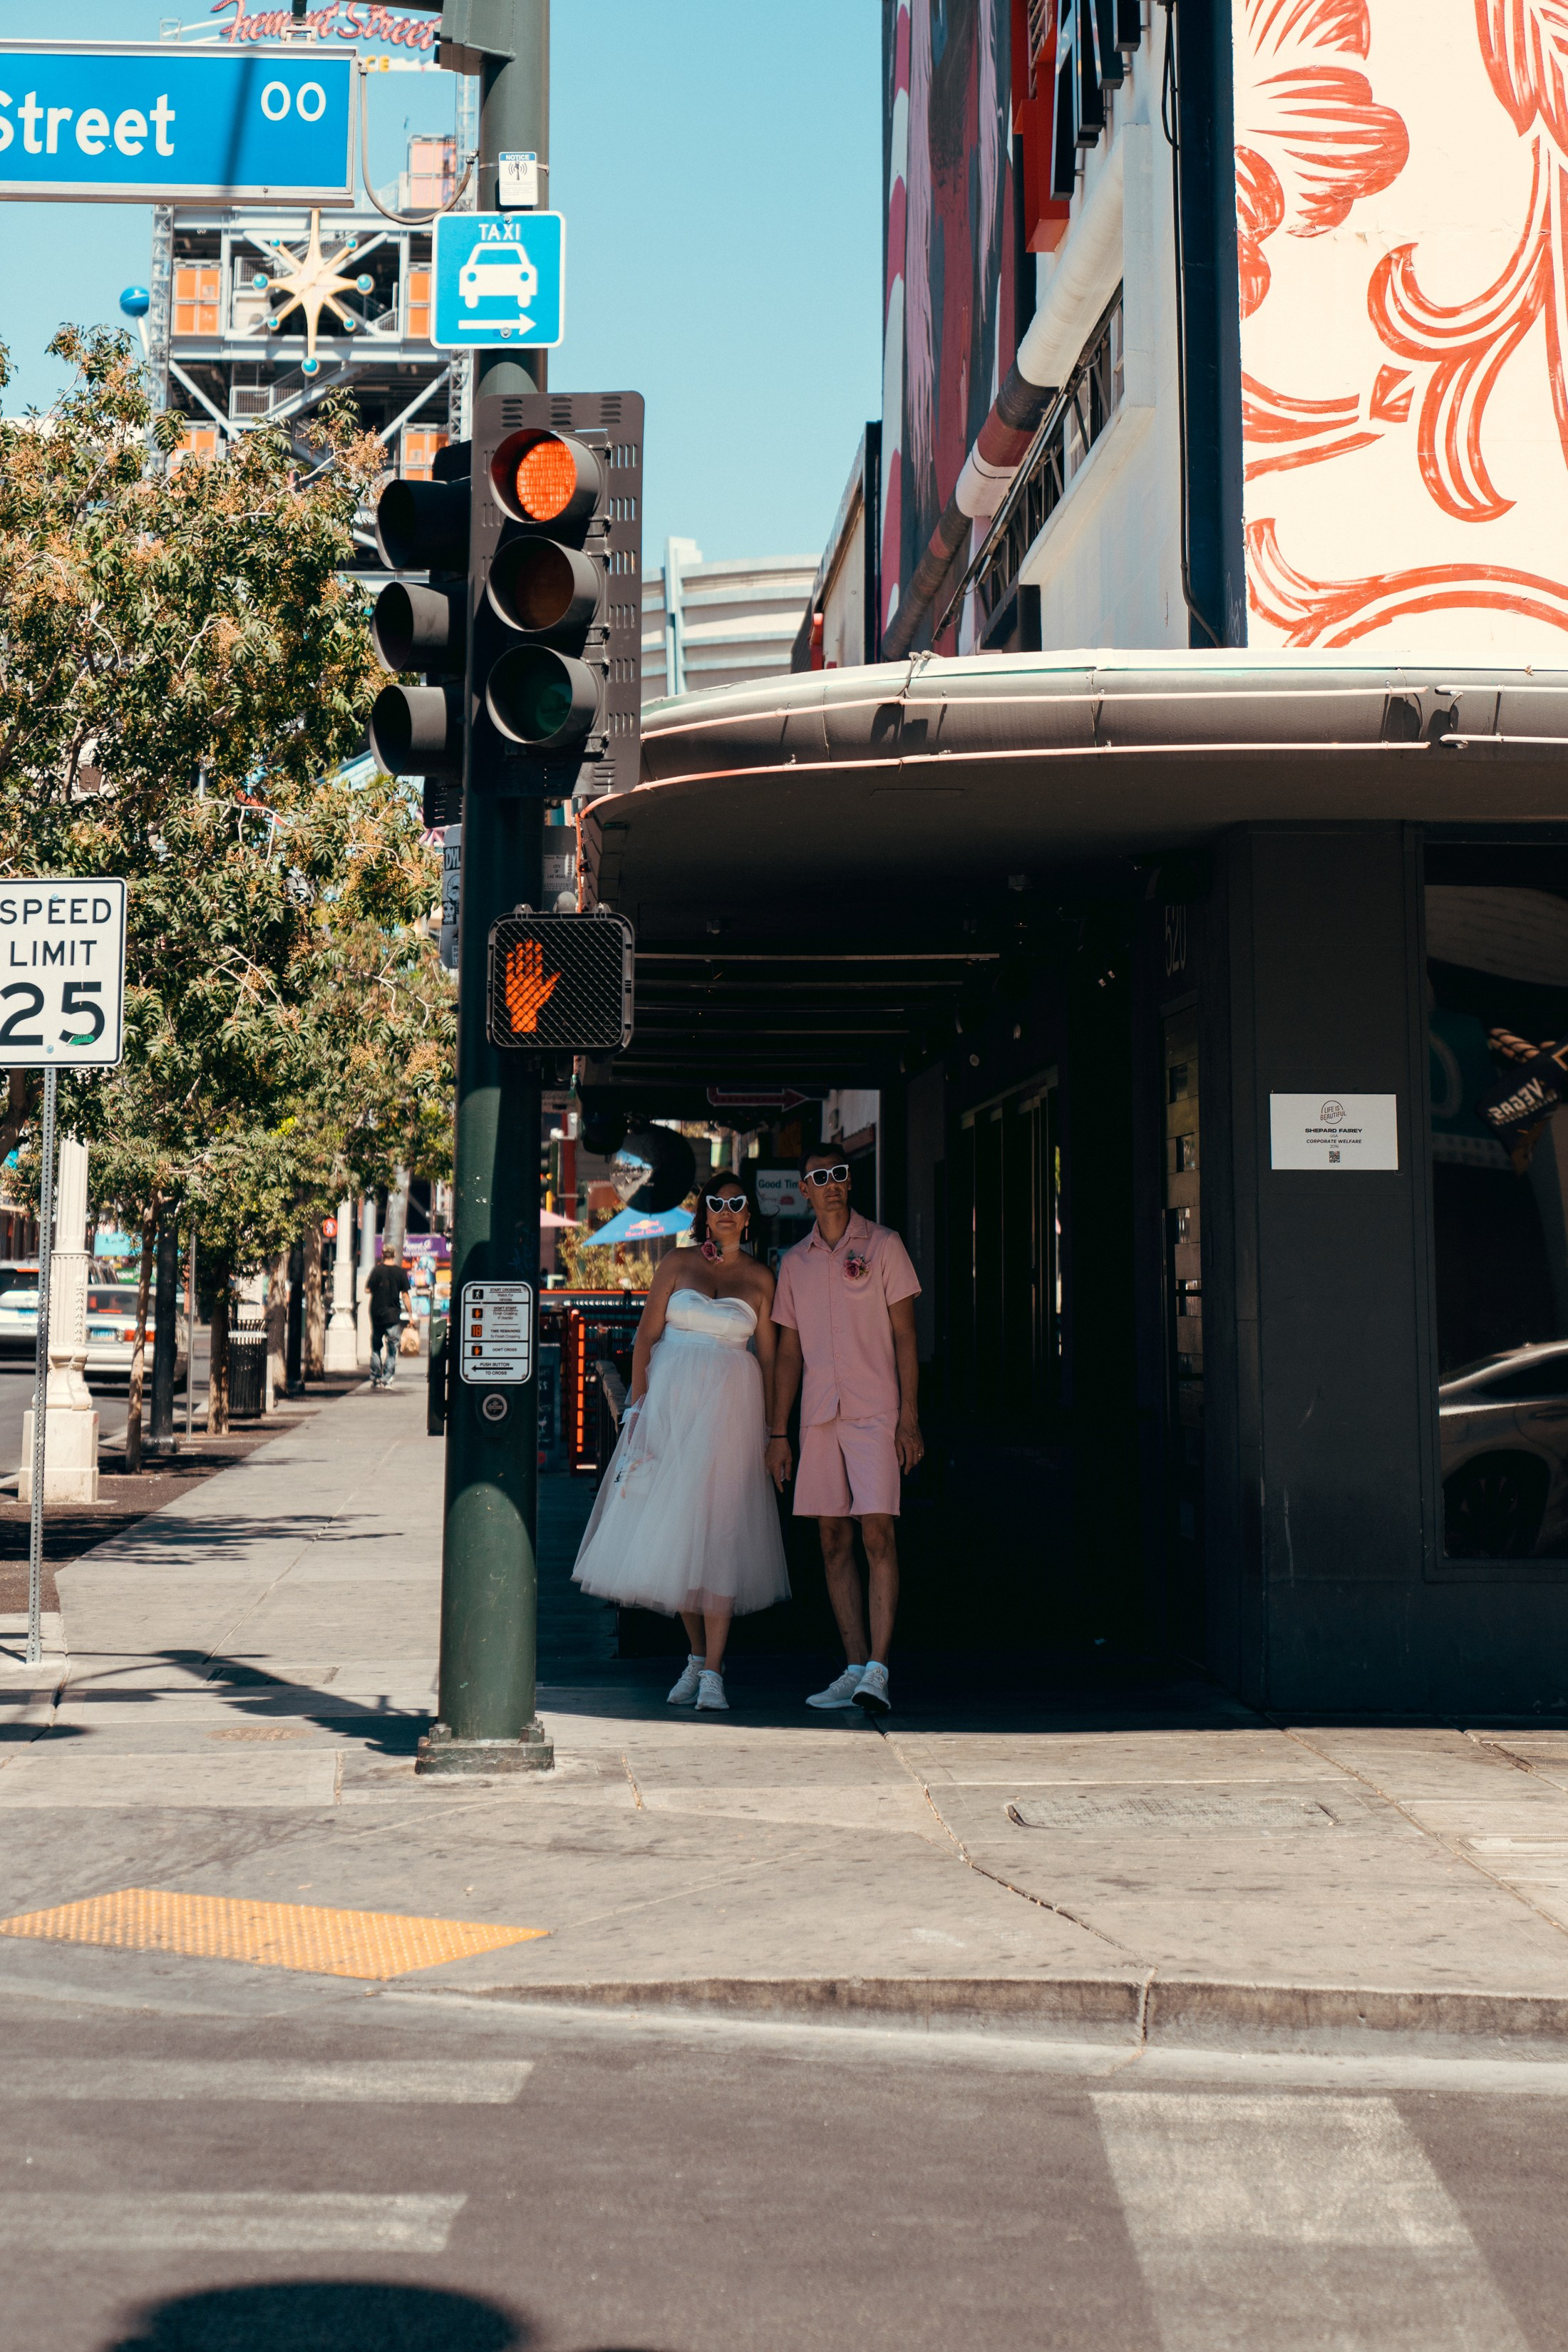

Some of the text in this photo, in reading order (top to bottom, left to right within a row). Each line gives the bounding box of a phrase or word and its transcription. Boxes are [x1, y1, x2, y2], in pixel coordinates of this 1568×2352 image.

[210, 0, 443, 50] Fremnt Street
[261, 81, 326, 122] 00
[478, 223, 521, 241] TAXI
[0, 898, 111, 924] SPEED
[10, 940, 97, 966] LIMIT
[1165, 904, 1187, 978] 520
[0, 981, 105, 1046] 25
[1320, 1111, 1347, 1121] BEAUTIFUL
[758, 1179, 781, 1189] Good
[473, 1326, 481, 1337] 18
